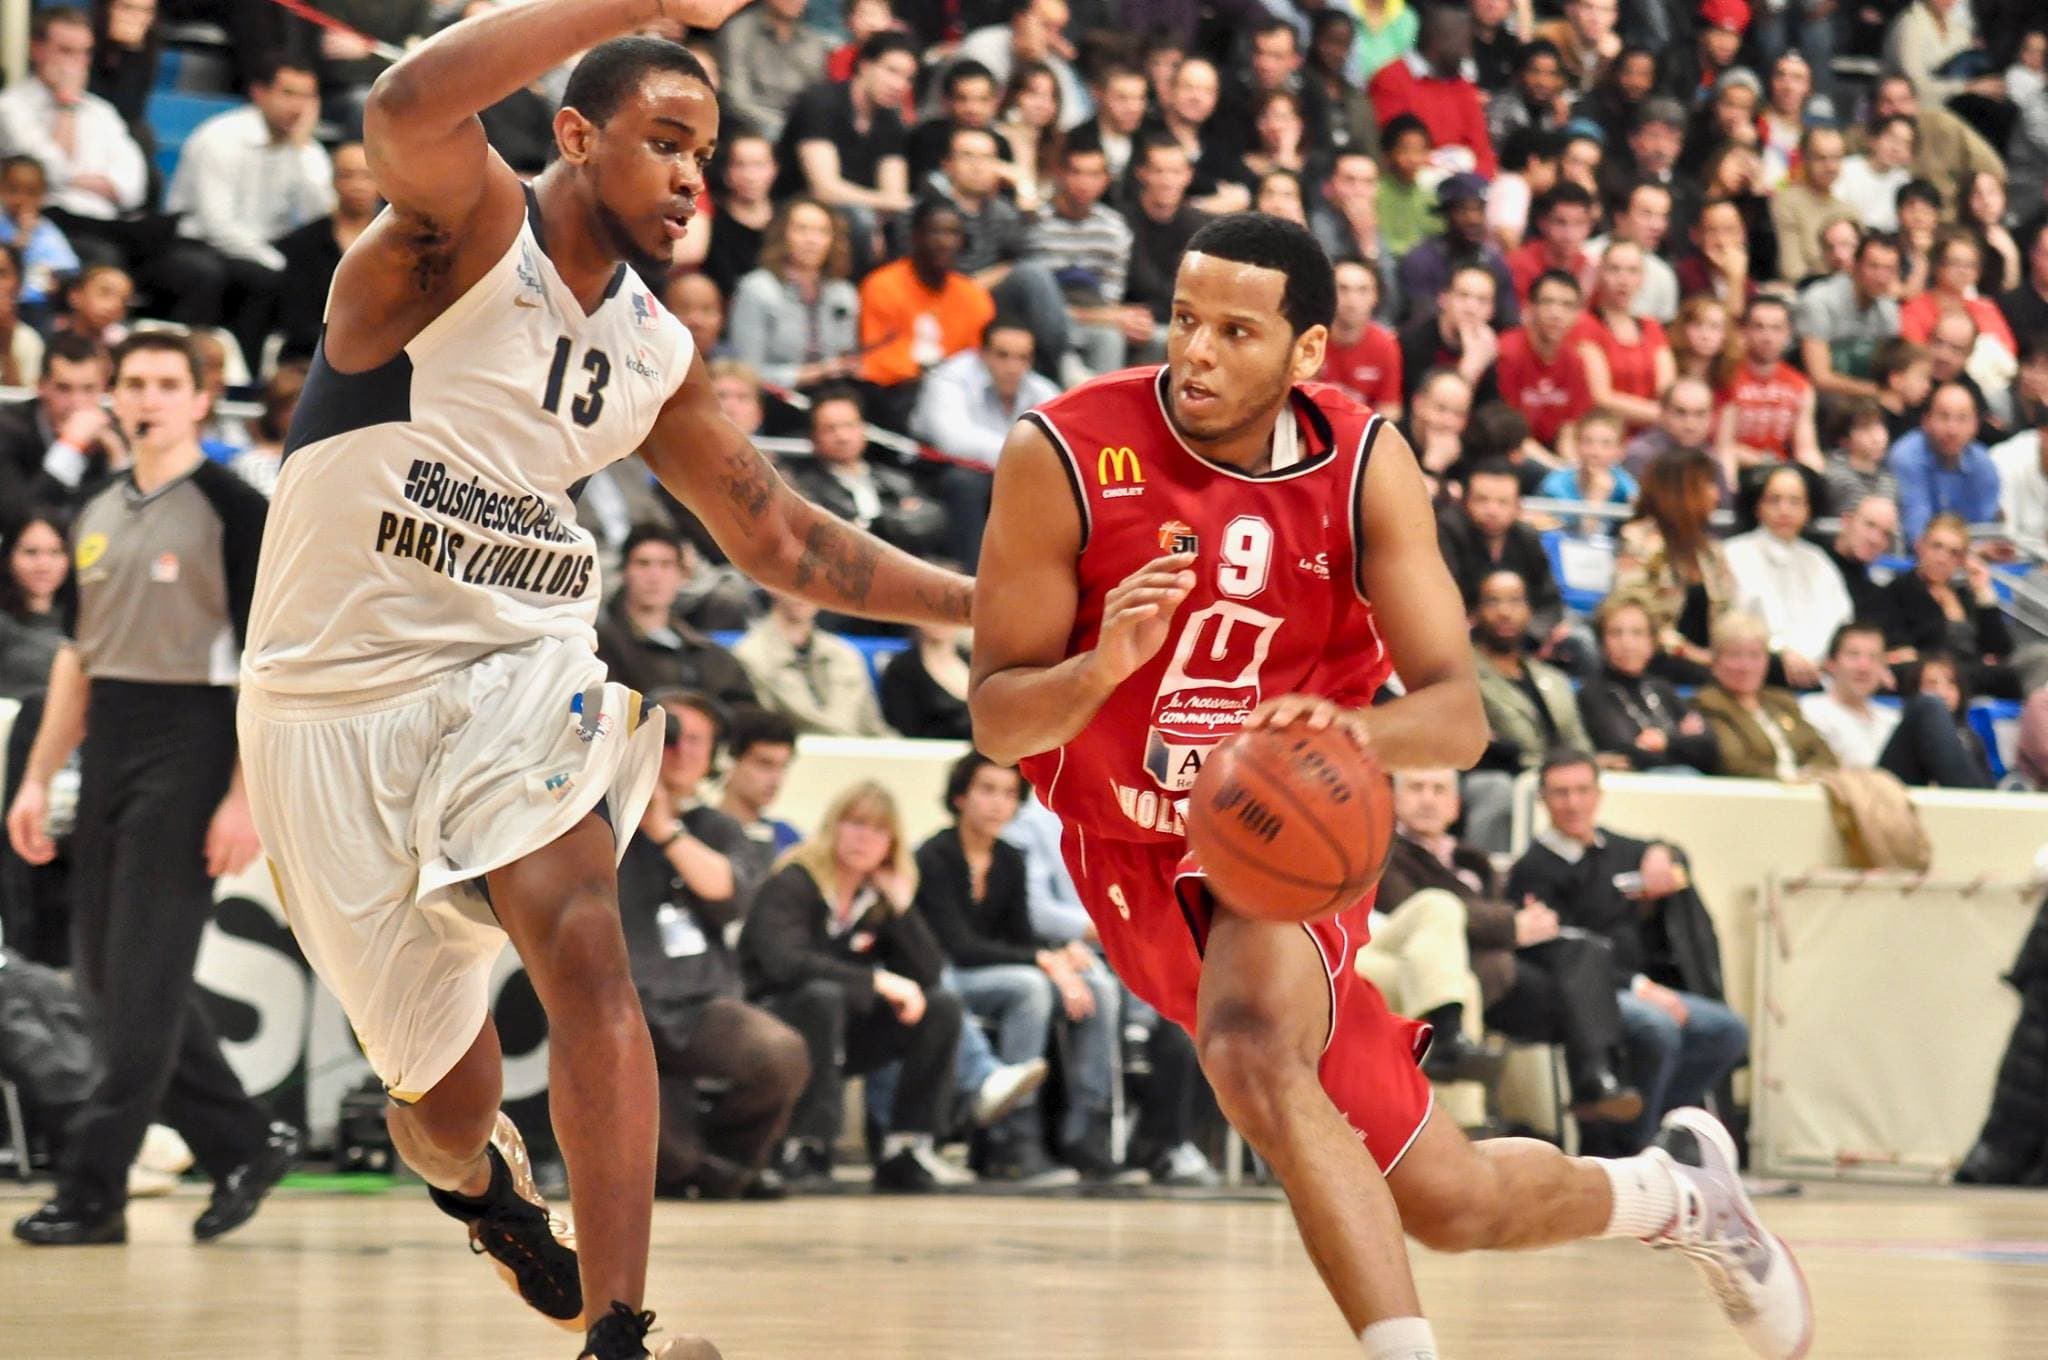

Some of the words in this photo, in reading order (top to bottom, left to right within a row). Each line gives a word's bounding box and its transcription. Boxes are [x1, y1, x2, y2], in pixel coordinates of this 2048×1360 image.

[542, 335, 611, 429] 13
[376, 511, 465, 578] PARIS
[462, 543, 594, 599] LEVALLOIS
[1217, 514, 1275, 600] 9
